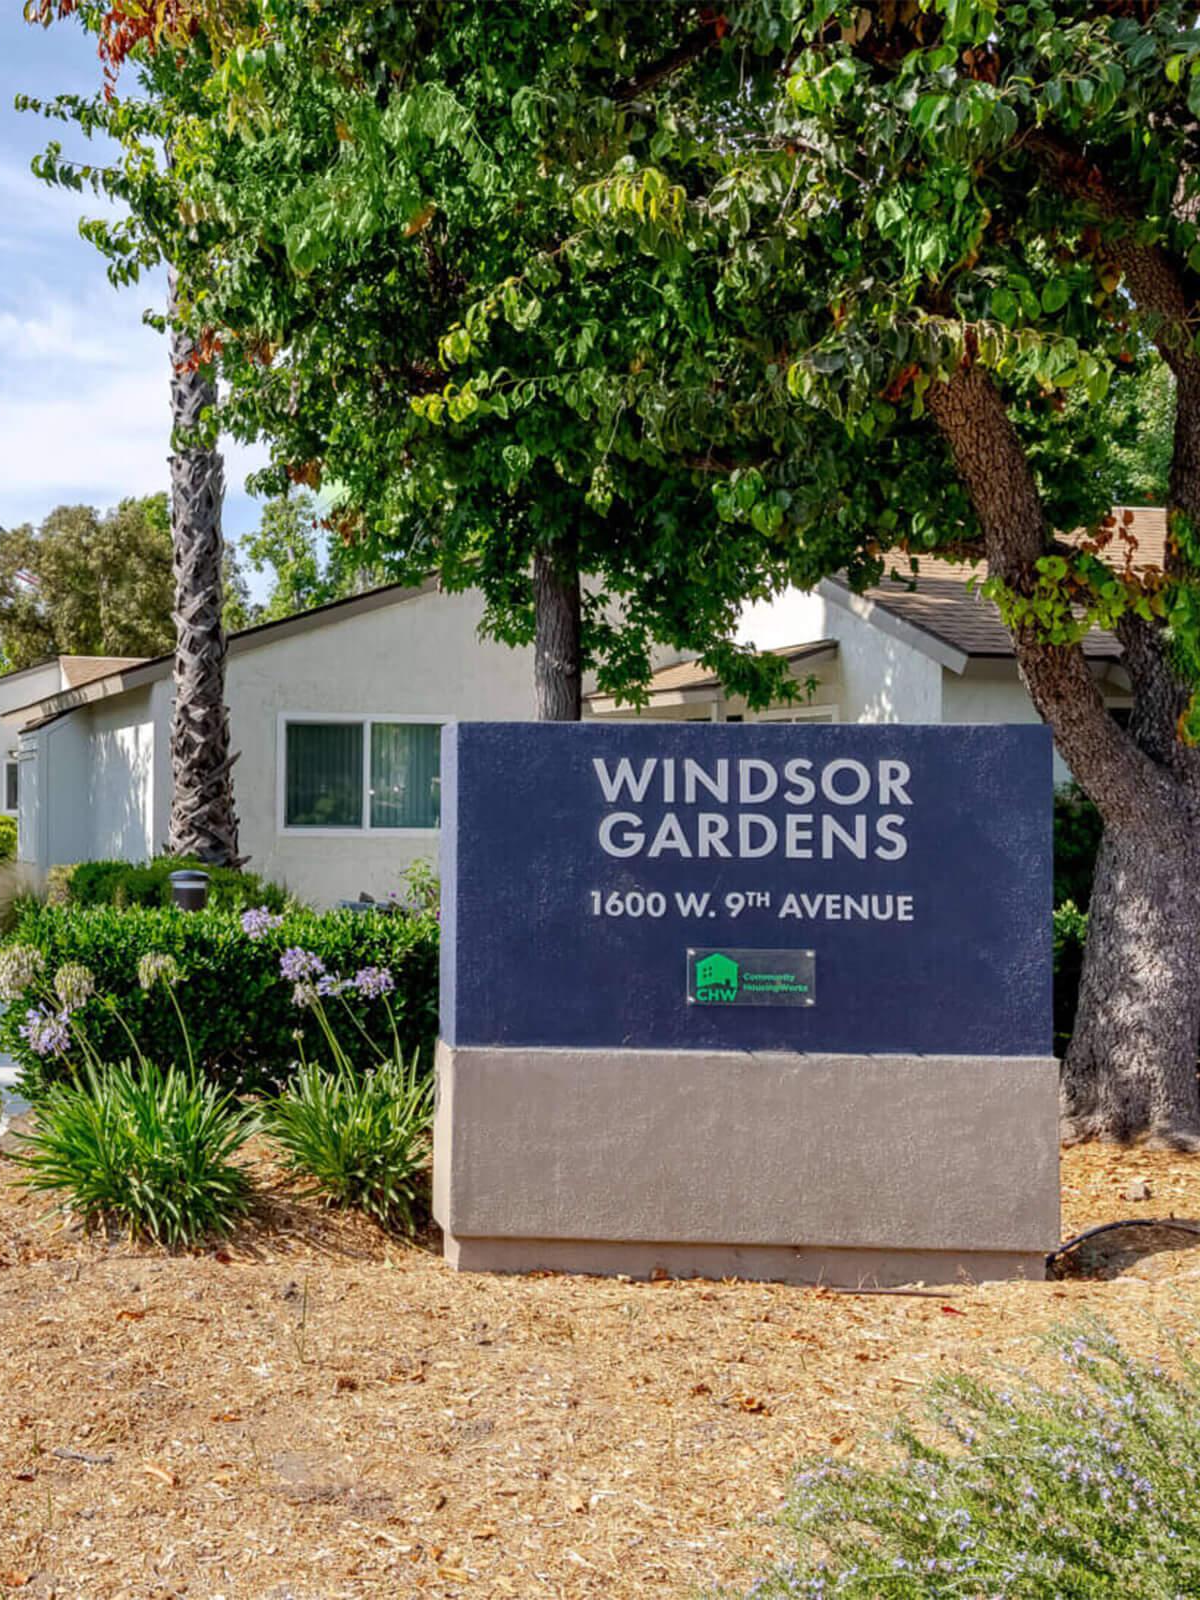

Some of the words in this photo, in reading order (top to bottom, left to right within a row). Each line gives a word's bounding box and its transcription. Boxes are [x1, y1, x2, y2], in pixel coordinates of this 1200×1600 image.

[593, 758, 913, 806] WINDSOR
[599, 812, 907, 861] GARDENS
[591, 890, 667, 918] 1600
[675, 891, 716, 918] W.
[725, 890, 771, 918] 9TH
[778, 893, 914, 921] AVENUE
[743, 972, 796, 982] Community
[696, 987, 737, 1002] CHW
